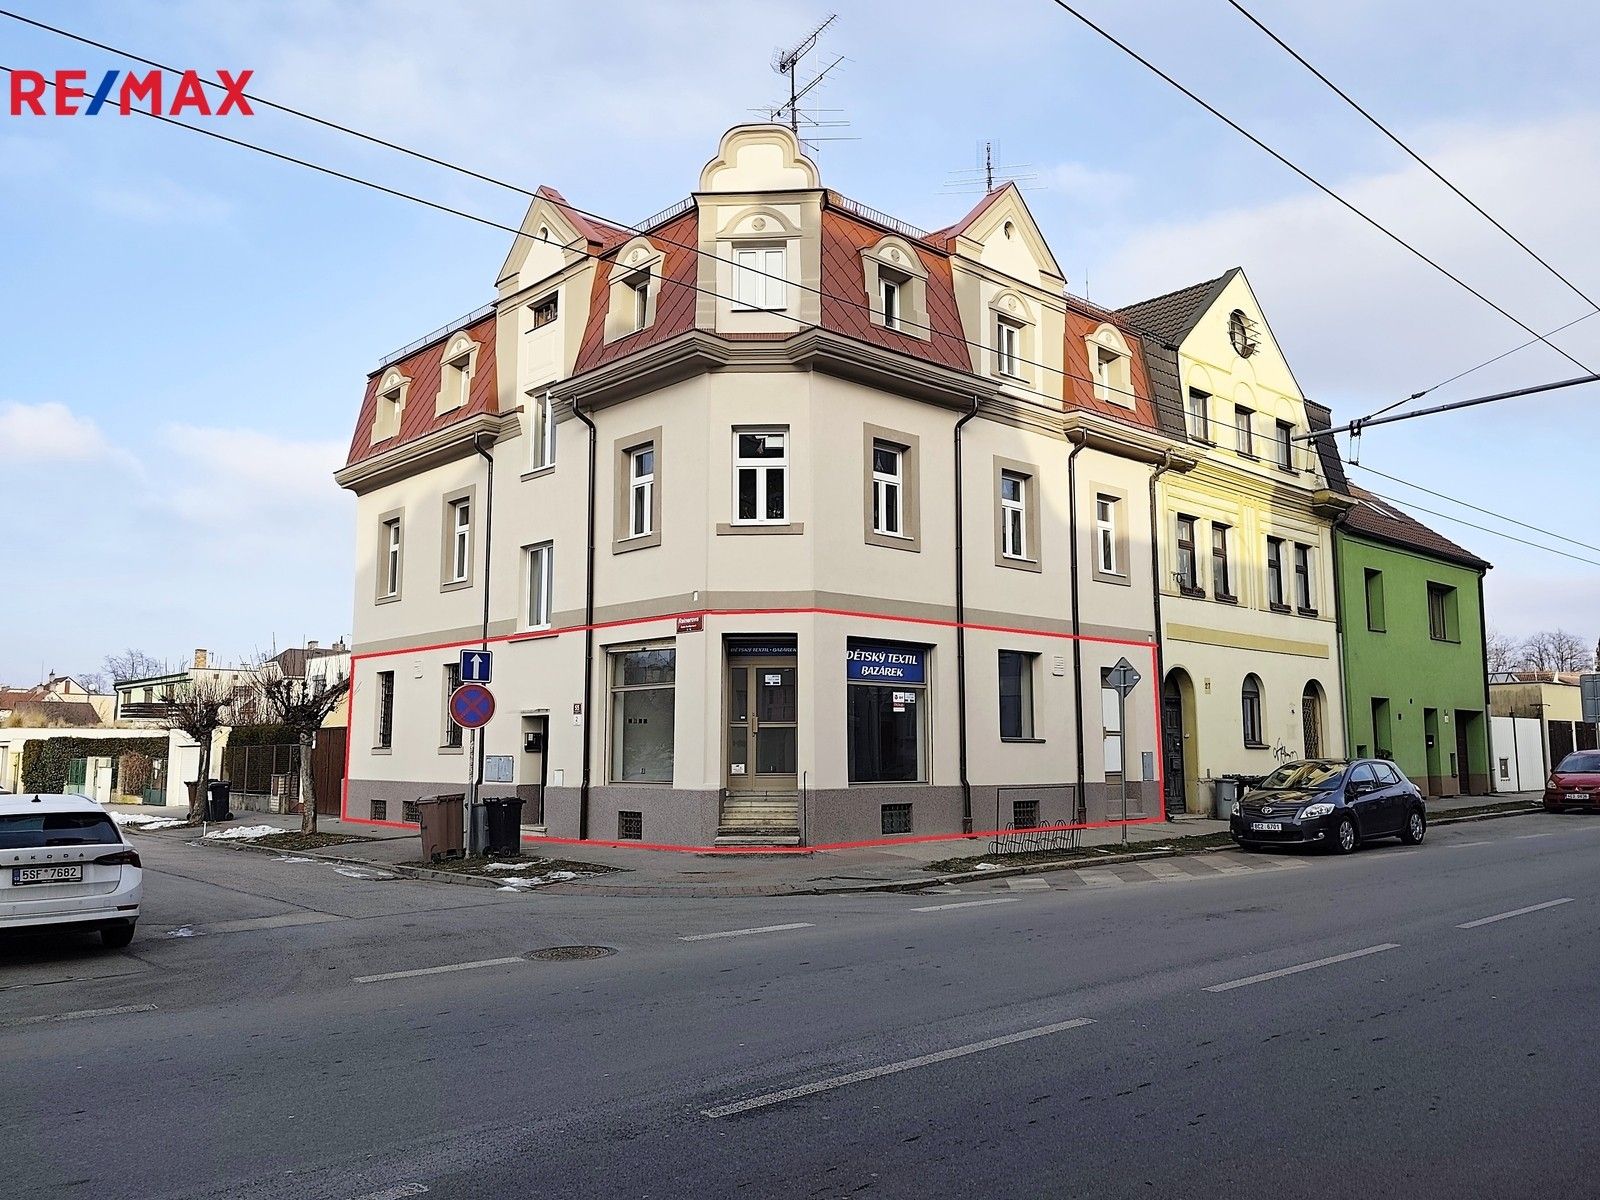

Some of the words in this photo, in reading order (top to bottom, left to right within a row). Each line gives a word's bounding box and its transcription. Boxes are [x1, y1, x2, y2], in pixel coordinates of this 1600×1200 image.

[846, 649, 886, 664] DĚTSKÝ
[887, 653, 918, 665] TEXTIL
[861, 666, 904, 677] BAZÁREK
[22, 870, 43, 880] 5SF
[50, 867, 77, 878] 7682
